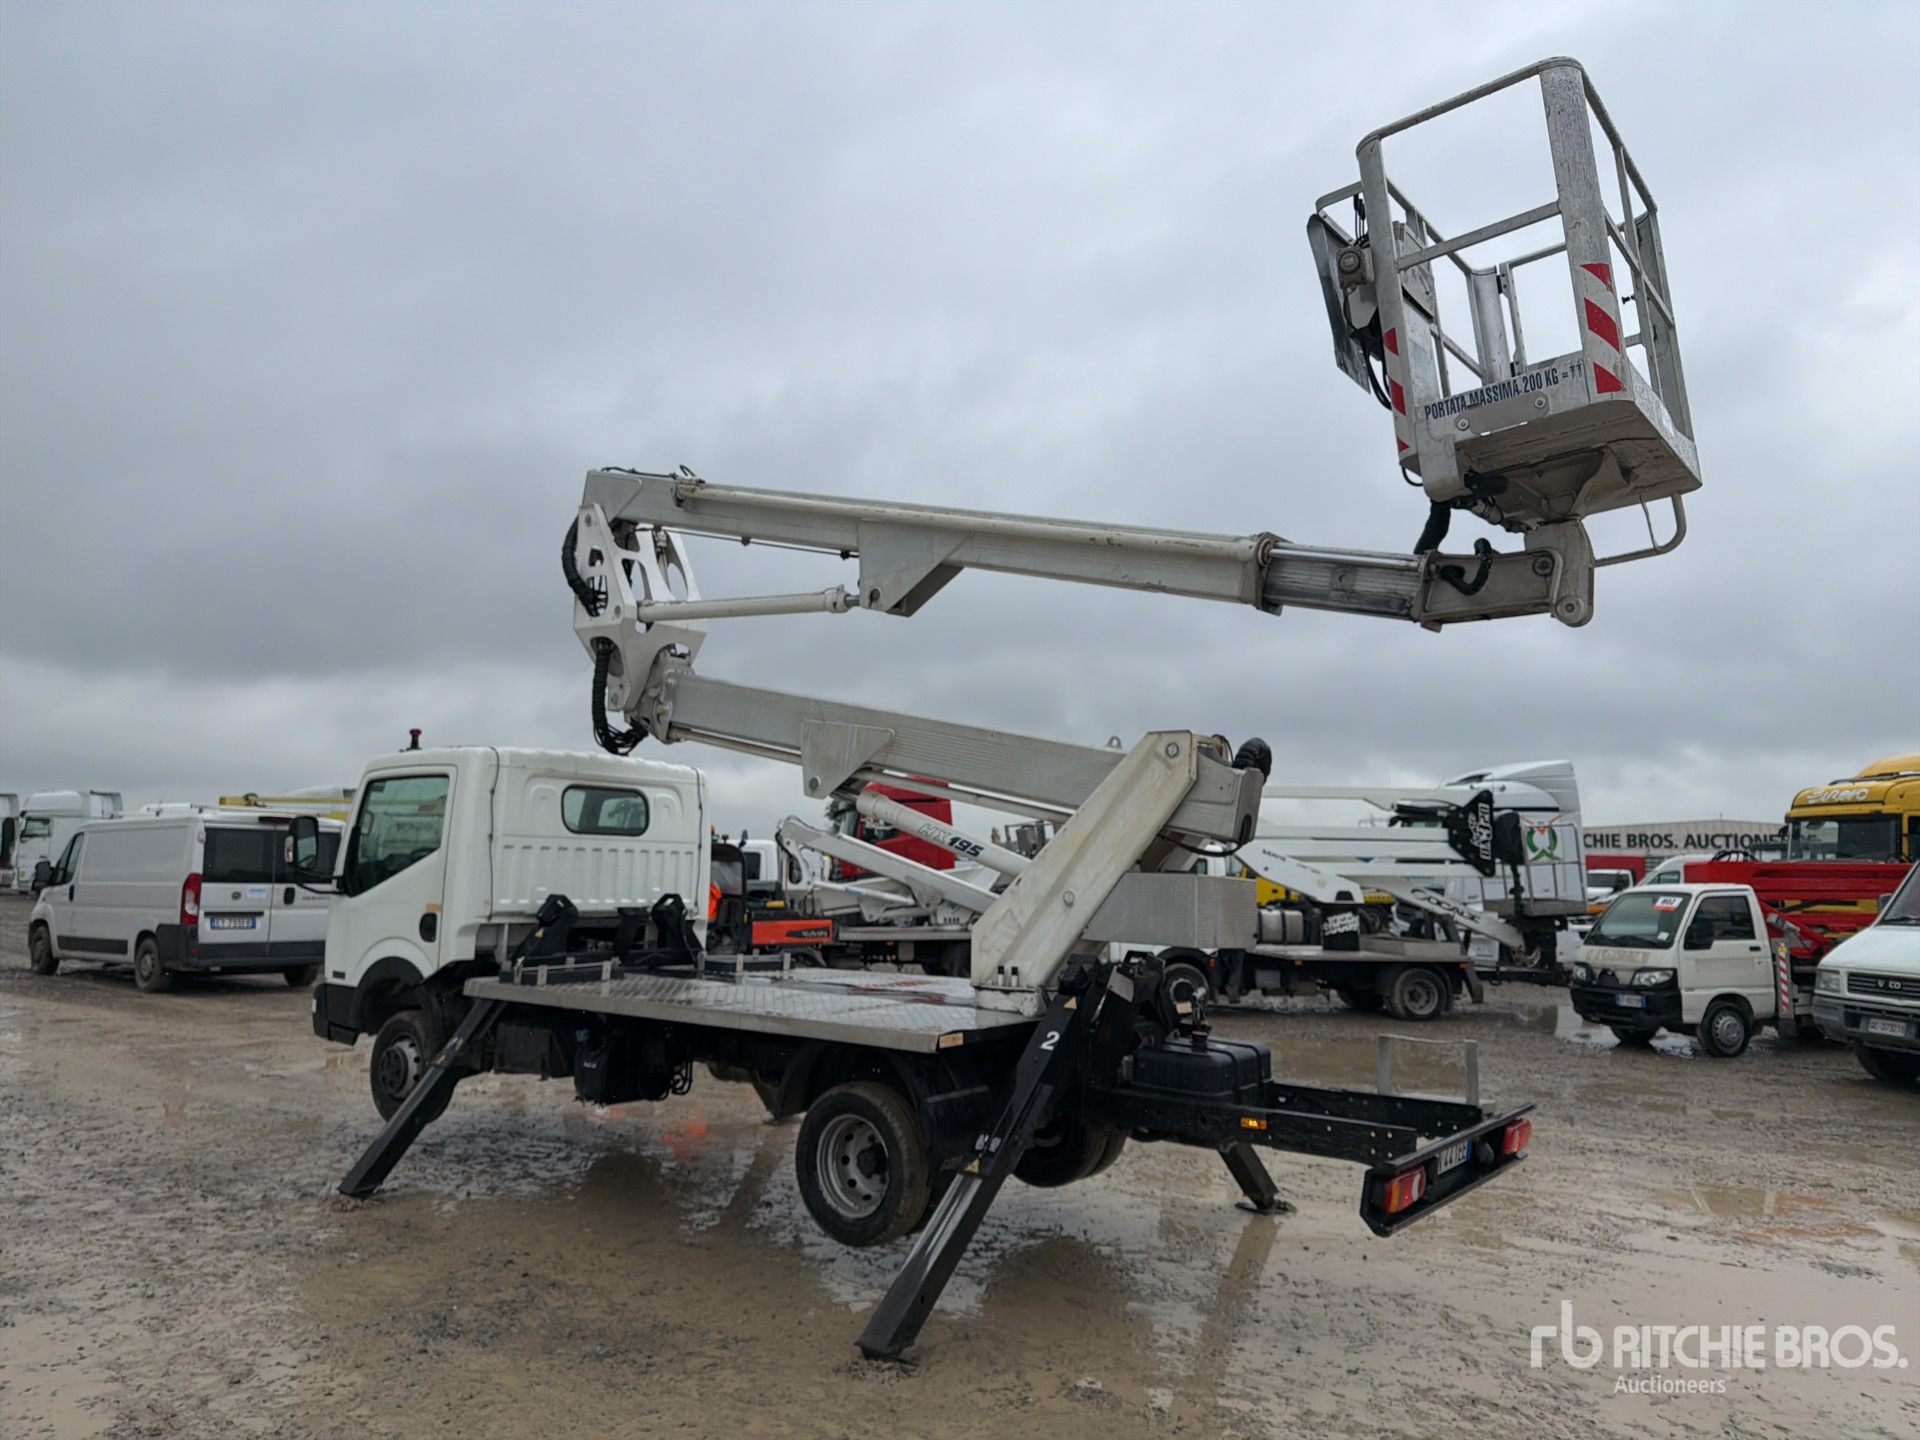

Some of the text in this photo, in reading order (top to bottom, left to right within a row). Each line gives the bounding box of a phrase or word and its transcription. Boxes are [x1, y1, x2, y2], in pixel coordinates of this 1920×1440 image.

[1424, 396, 1468, 420] PORTATA
[1469, 380, 1520, 405] MASSIMA
[1523, 372, 1542, 394] 200
[1545, 367, 1559, 387] KG
[1627, 833, 1679, 849] BROS.
[1040, 1031, 1060, 1051] 2
